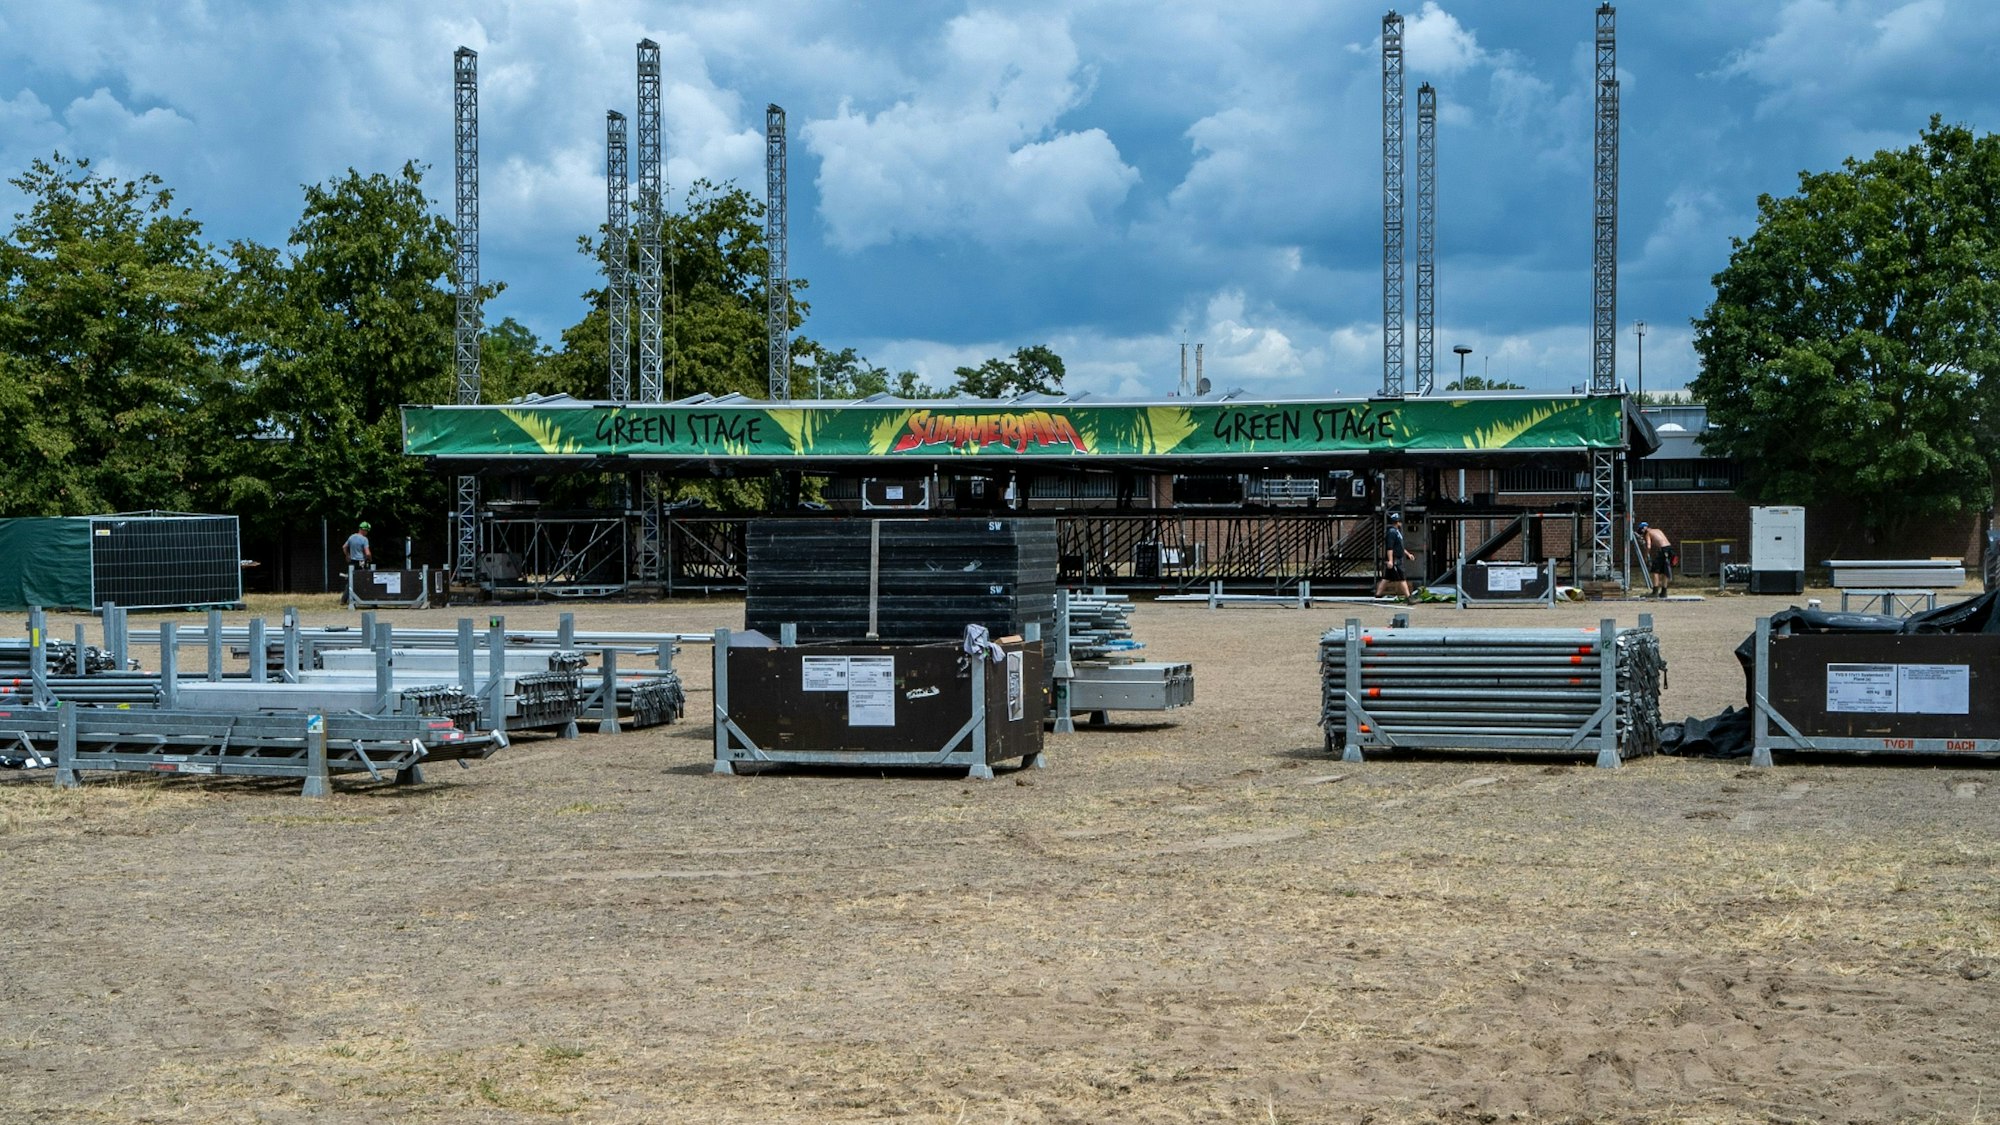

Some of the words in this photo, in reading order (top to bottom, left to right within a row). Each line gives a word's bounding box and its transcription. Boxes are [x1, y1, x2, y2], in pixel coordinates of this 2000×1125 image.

[595, 414, 675, 446] GREEN
[687, 413, 762, 446] STAGE
[893, 409, 1088, 454] SUMMERJAM
[1213, 410, 1300, 444] GREEN
[1313, 408, 1394, 442] STAGE
[988, 521, 1002, 531] SW
[989, 585, 1003, 595] SW
[1947, 741, 1975, 750] DACH
